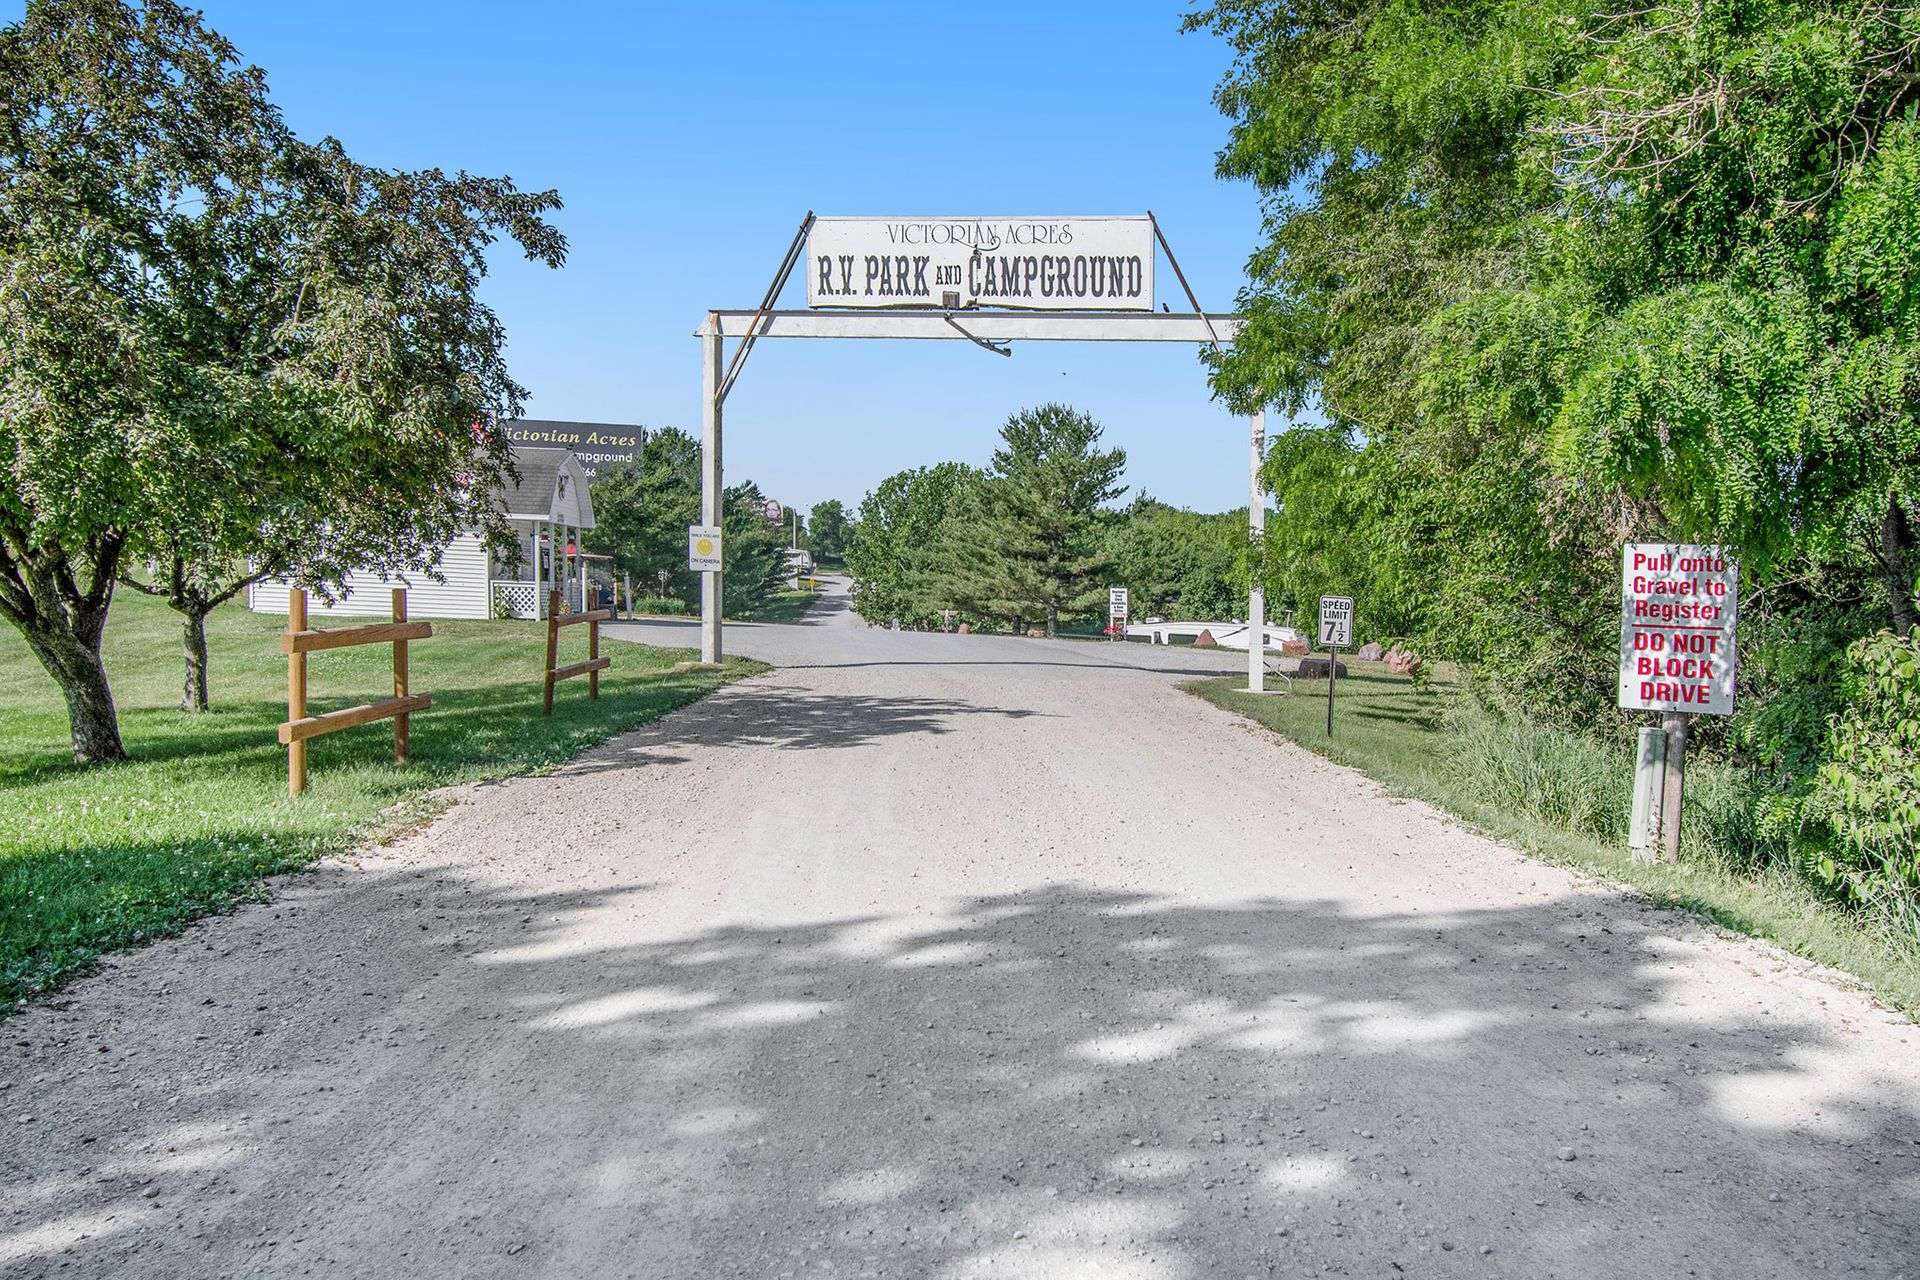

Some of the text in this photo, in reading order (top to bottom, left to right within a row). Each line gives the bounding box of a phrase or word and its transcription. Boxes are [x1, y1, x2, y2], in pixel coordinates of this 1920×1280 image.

[887, 224, 1073, 251] VICTORIAN ACRES
[817, 254, 1143, 298] R.V. PARK AND CAMPGROUND
[586, 431, 637, 447] Acres
[582, 467, 597, 477] 66
[1633, 553, 1726, 572] Pull onto
[1633, 576, 1726, 596] Gravel to
[1322, 600, 1350, 610] SPEED
[1324, 610, 1348, 619] LIMIT
[1635, 599, 1722, 622] Register
[1634, 632, 1720, 654] DO NOT
[1638, 657, 1713, 679] BLOCK
[1640, 682, 1710, 704] DRIVE
